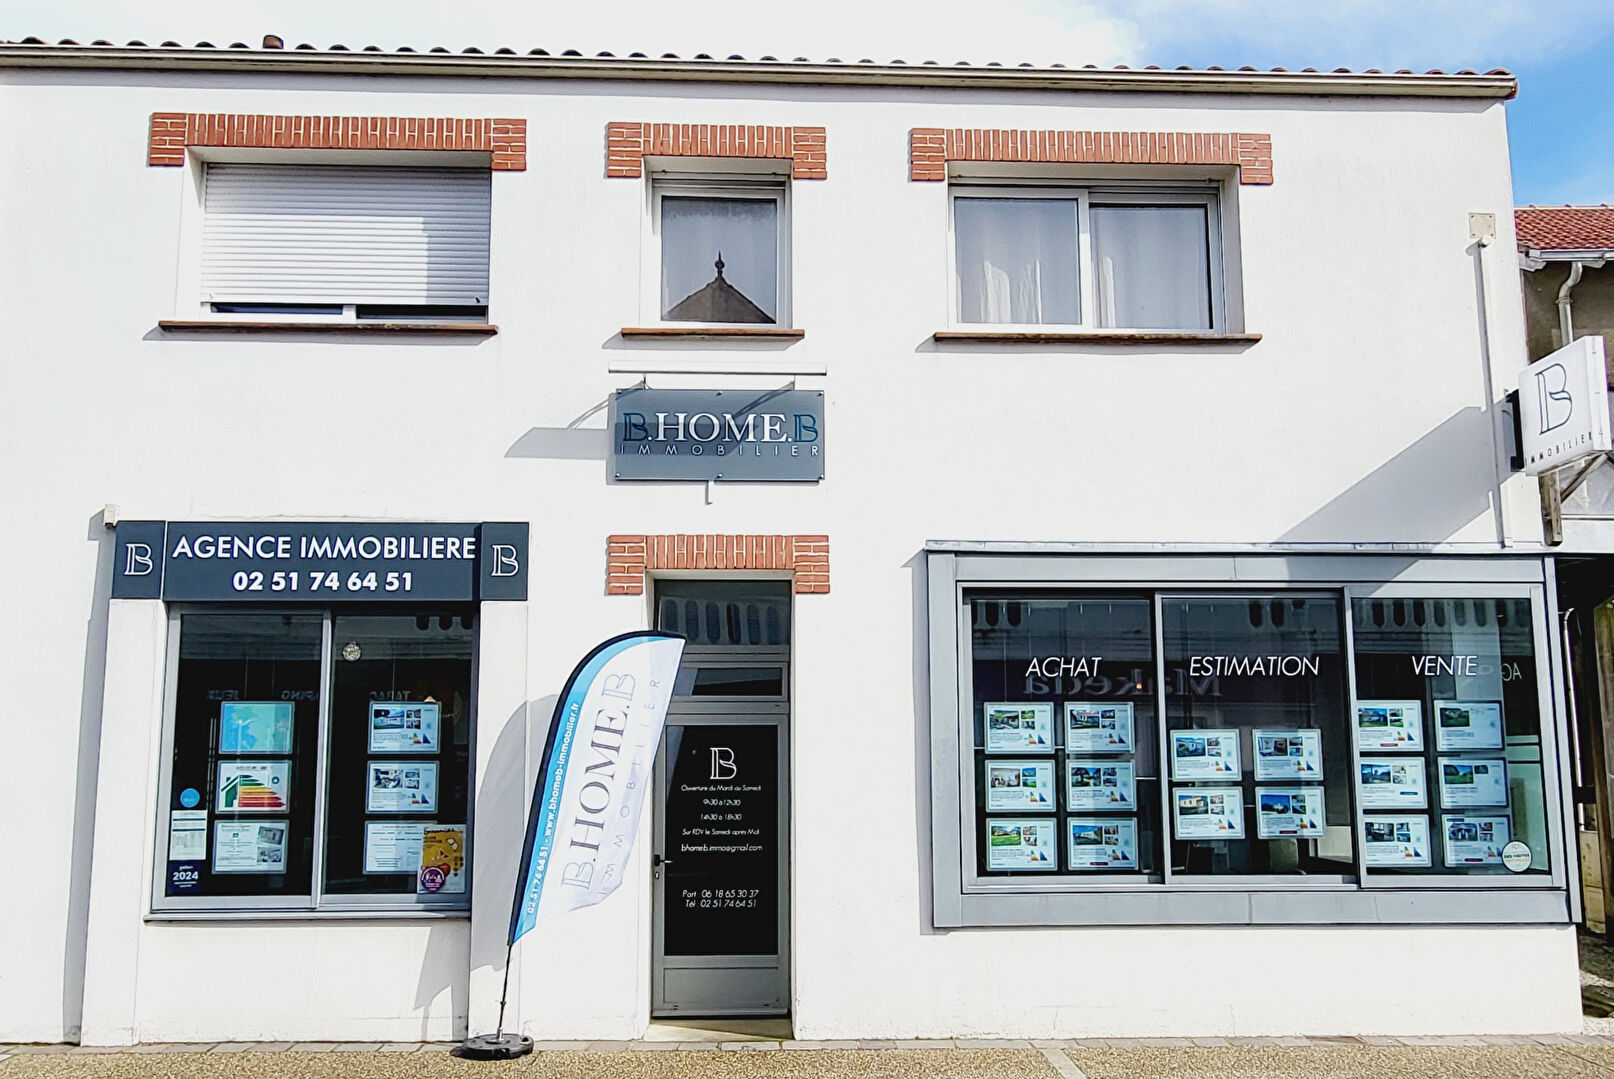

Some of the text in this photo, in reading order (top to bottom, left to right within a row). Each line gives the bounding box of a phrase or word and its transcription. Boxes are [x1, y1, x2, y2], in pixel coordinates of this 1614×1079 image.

[1535, 363, 1572, 435] B
[622, 412, 818, 443] B.HOME.B
[619, 445, 819, 456] IMMOBILIER
[172, 536, 476, 560] AGENCE IMMOBILIERE
[123, 544, 153, 576] B
[491, 544, 519, 577] B
[232, 571, 412, 592] 02 51 74 64 51
[1025, 656, 1102, 678] ACHAT
[1189, 655, 1320, 677] ESTIMATION
[1411, 655, 1478, 676] VENTE
[710, 747, 737, 780] B
[680, 784, 708, 792] Ouverture
[703, 798, 718, 806] 9h30
[723, 798, 741, 806] 12h30
[700, 813, 718, 821] 14h30
[539, 846, 549, 857] 51
[536, 858, 546, 872] 64
[172, 870, 199, 881] 2024
[533, 873, 542, 886] 74
[530, 888, 539, 899] 51
[701, 889, 712, 898] 06
[715, 889, 724, 898] 18
[725, 889, 736, 898] 65
[737, 889, 748, 898] 30
[748, 889, 760, 898] 37
[527, 901, 536, 914] 02
[700, 899, 711, 908] 02
[712, 899, 722, 908] 51
[723, 899, 734, 908] 74
[735, 899, 746, 908] 64
[747, 899, 757, 908] 51
